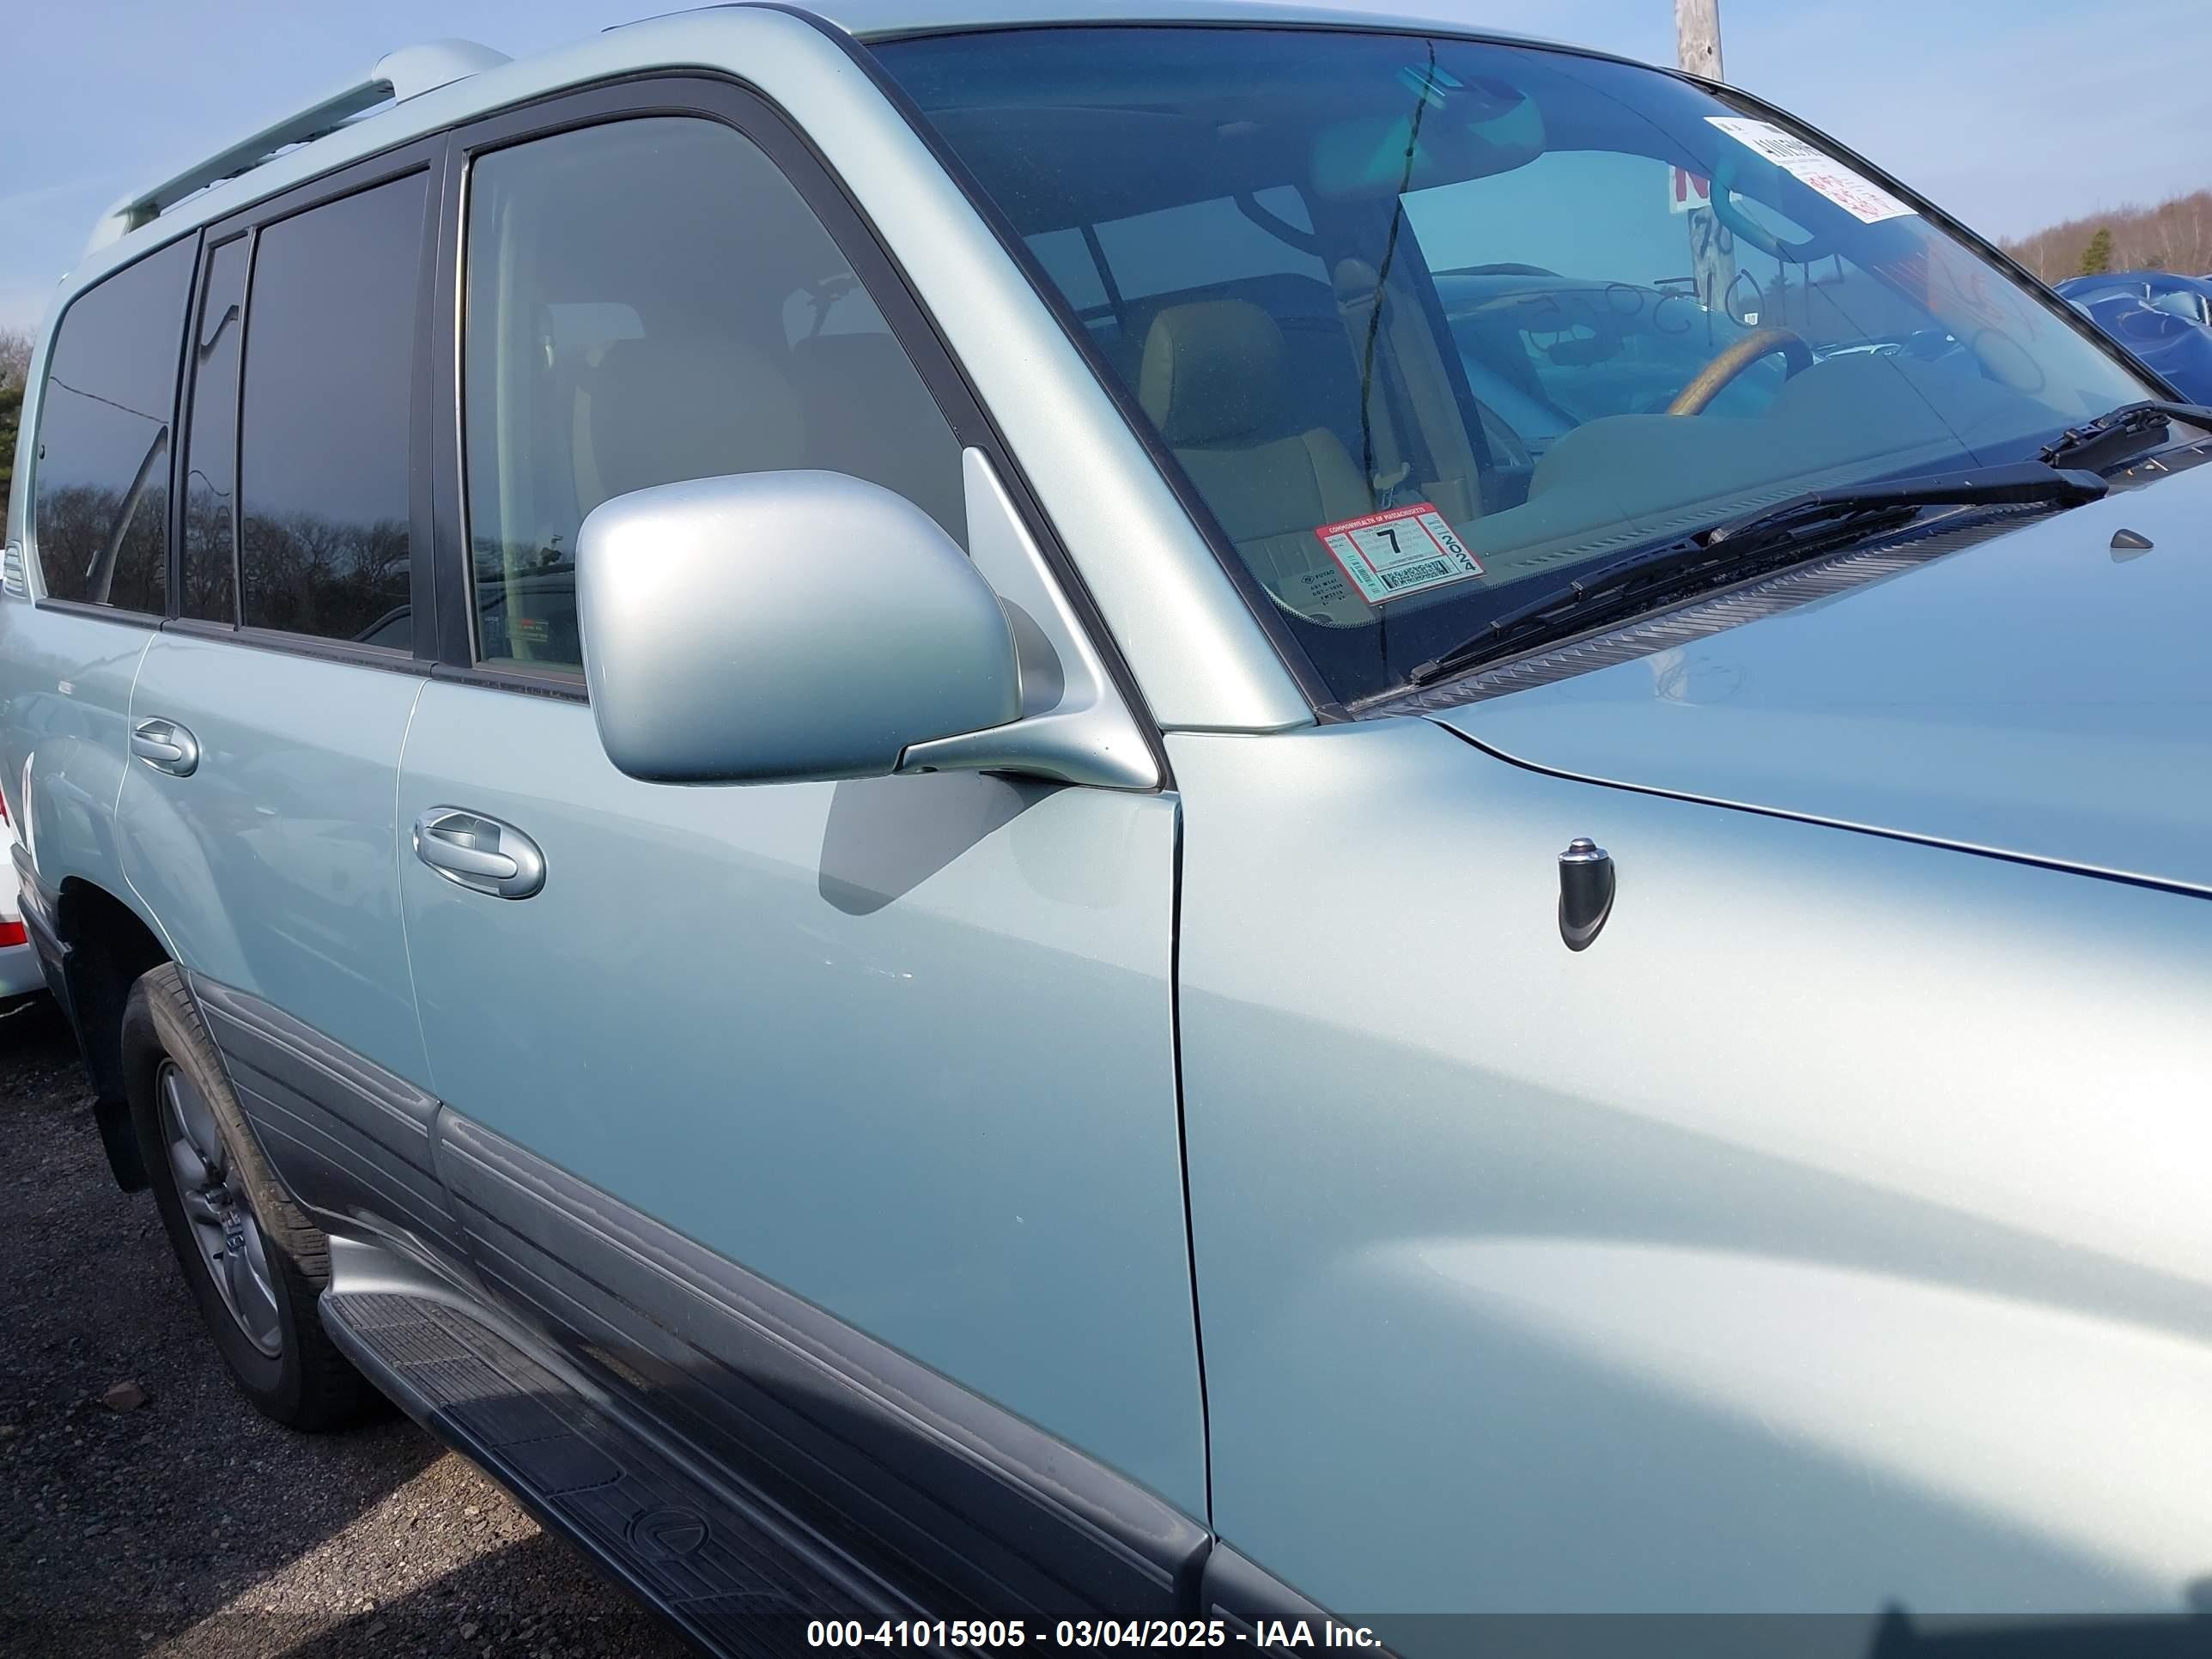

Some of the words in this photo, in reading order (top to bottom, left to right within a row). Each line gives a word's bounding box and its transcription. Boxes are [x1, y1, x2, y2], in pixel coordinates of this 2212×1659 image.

[1328, 517, 1376, 533] COMMONWEALTH
[1376, 529, 1401, 554] 7
[1442, 535, 1477, 571] 2024
